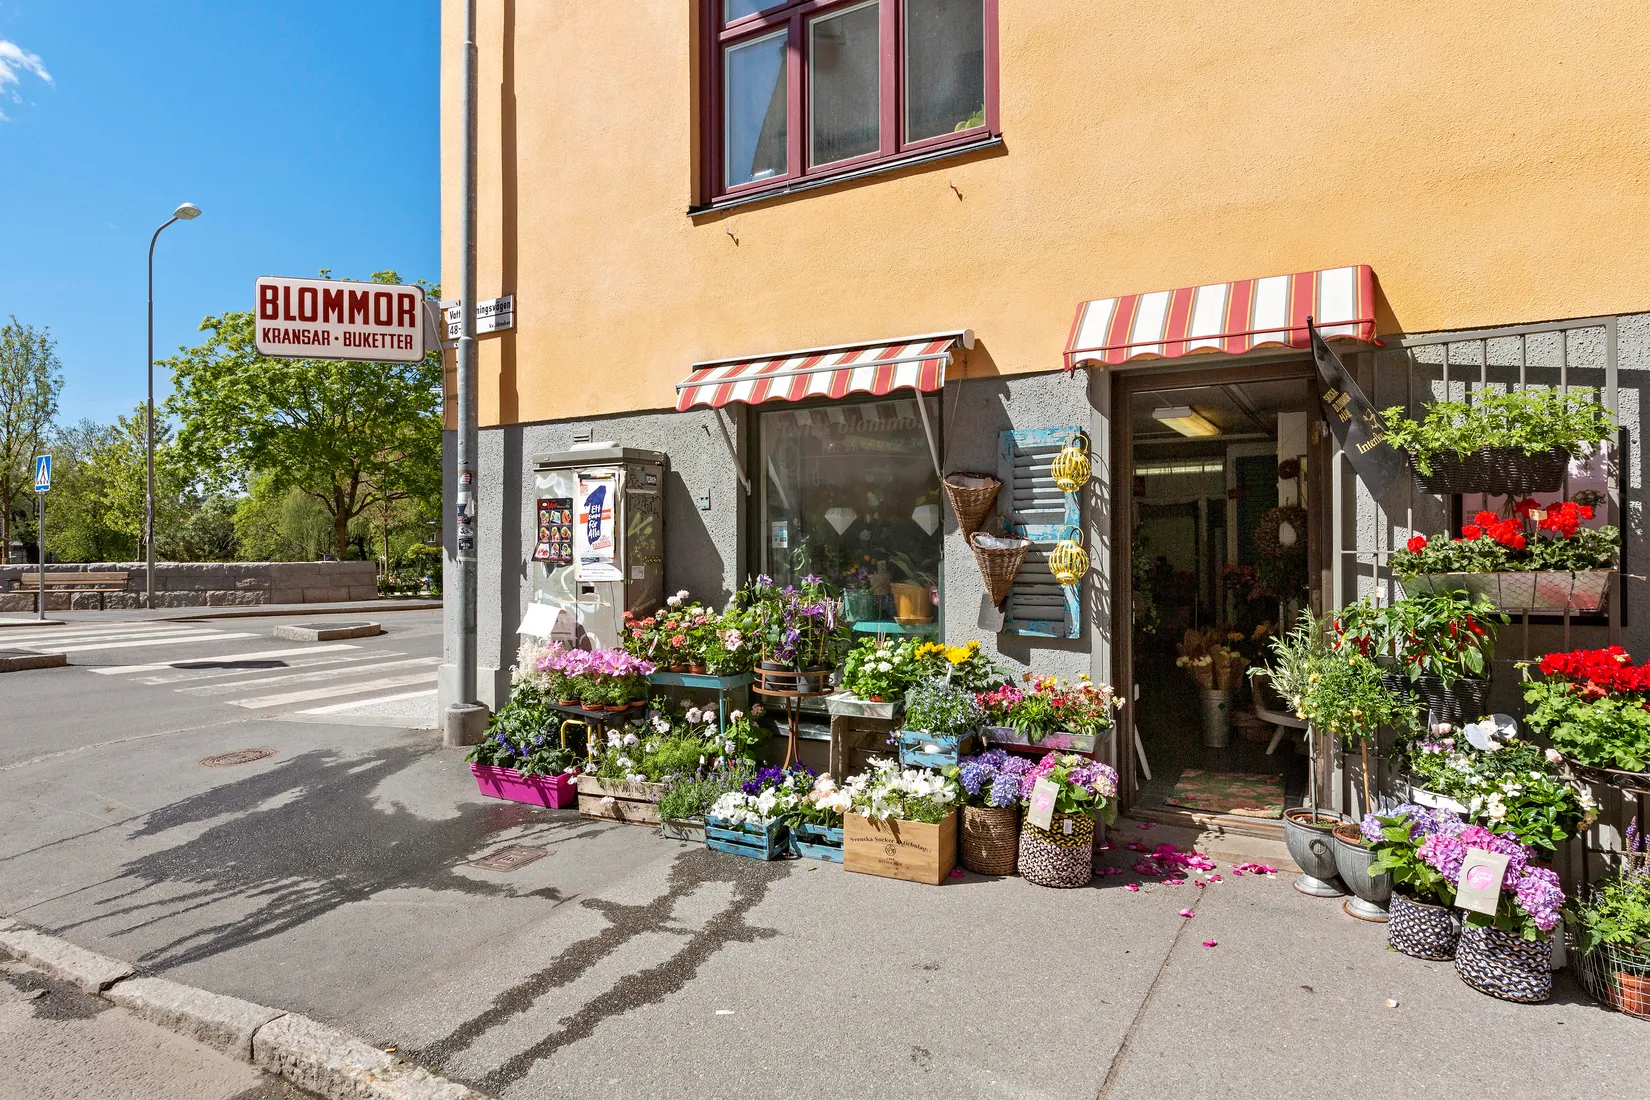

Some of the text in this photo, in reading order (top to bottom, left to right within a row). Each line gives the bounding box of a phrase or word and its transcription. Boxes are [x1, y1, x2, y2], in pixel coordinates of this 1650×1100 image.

[259, 284, 416, 328] BLOMMOR
[262, 327, 413, 350] KRANSAR BUKETTER
[1356, 432, 1386, 454] Interflo
